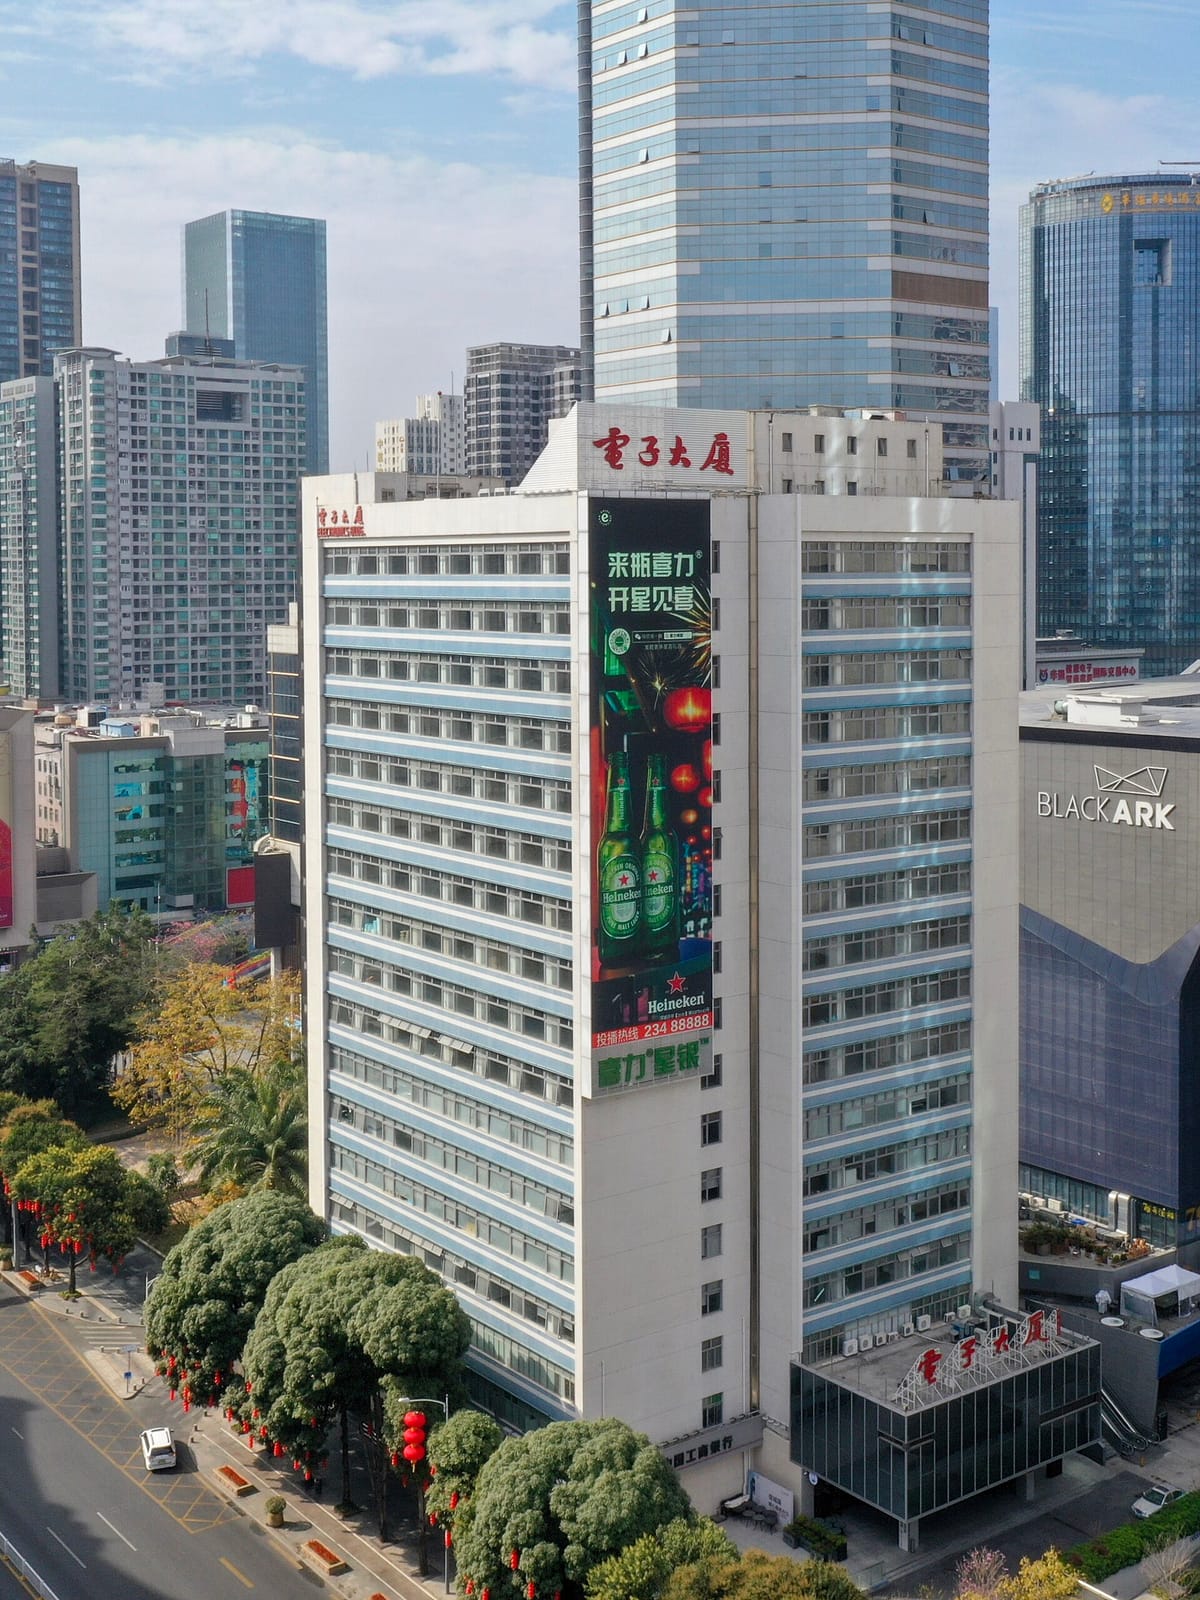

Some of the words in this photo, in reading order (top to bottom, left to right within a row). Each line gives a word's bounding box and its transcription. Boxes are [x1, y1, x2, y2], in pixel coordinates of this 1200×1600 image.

[608, 585, 694, 613] 开星见喜
[648, 994, 704, 1014] Heineken
[644, 1022, 667, 1038] 234
[670, 1015, 710, 1032] 88888
